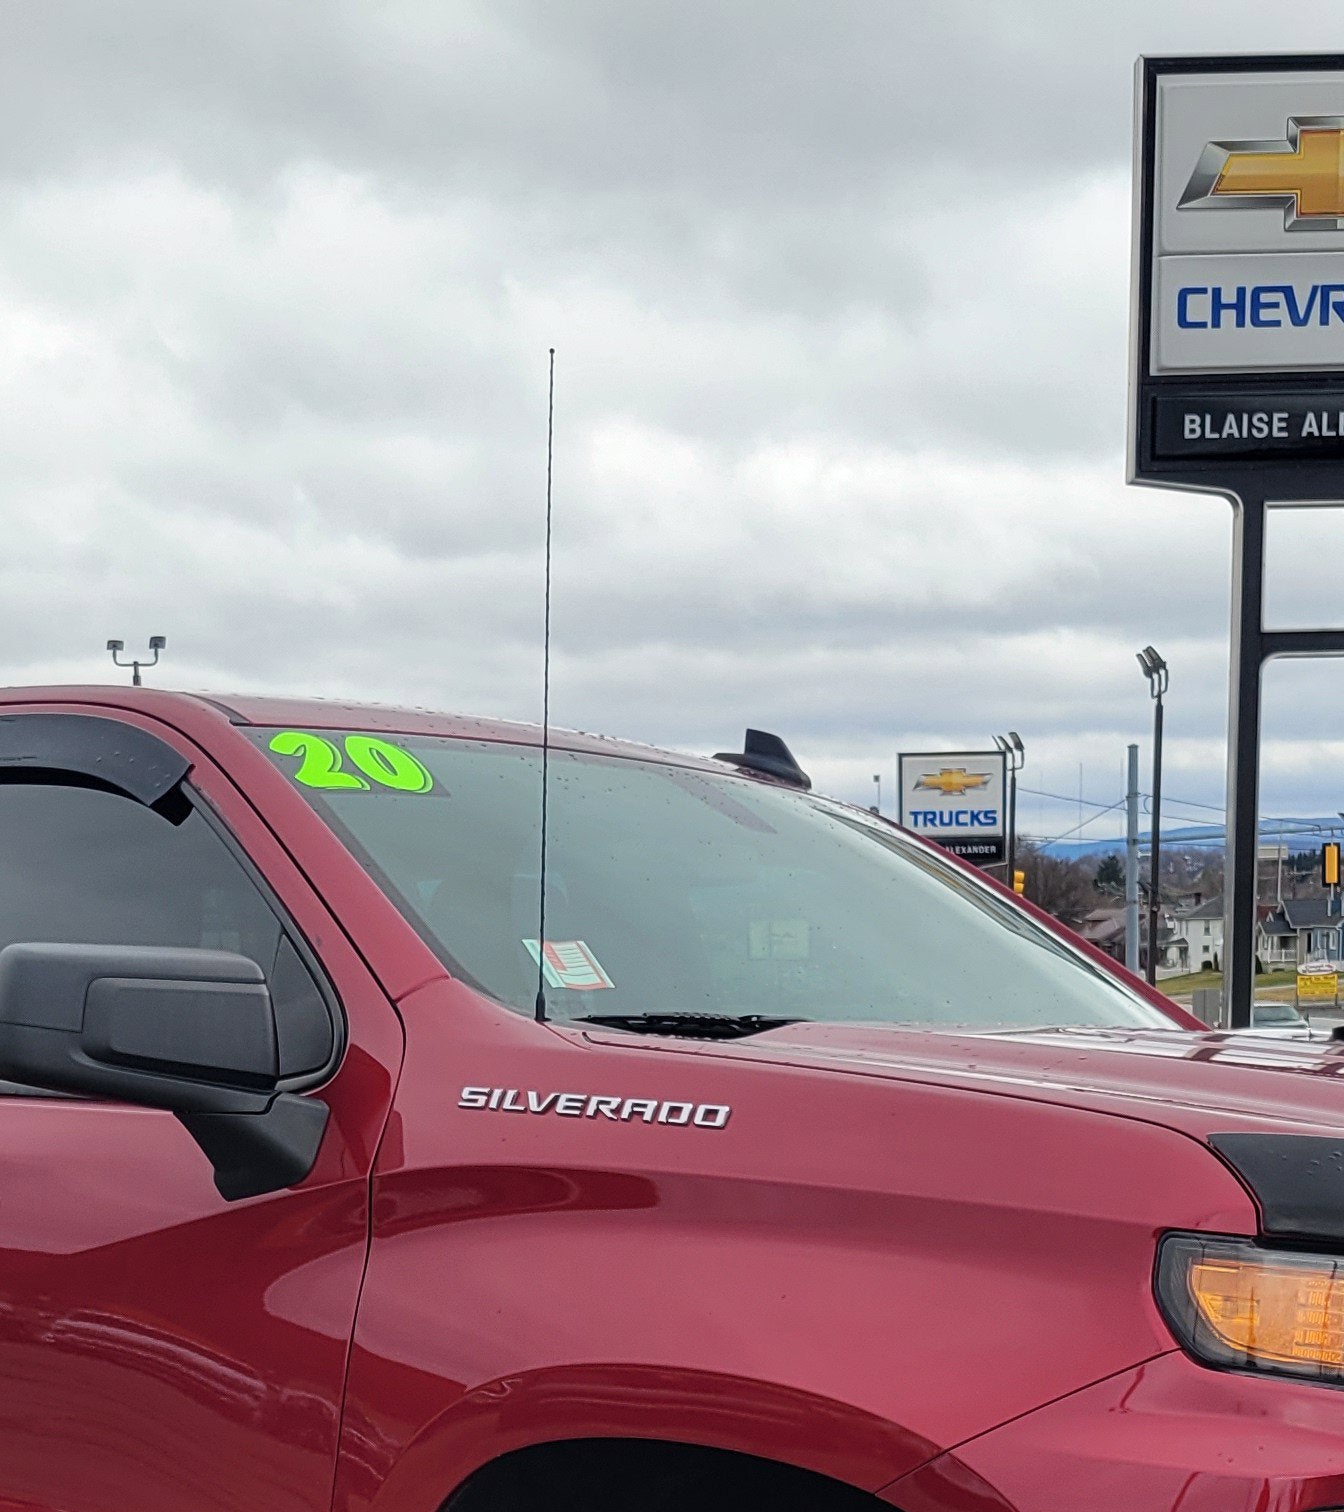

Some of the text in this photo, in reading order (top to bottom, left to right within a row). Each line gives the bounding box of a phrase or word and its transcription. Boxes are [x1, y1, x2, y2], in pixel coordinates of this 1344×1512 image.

[1183, 411, 1289, 439] BLAISE
[268, 731, 434, 794] 20
[909, 809, 997, 828] TRUCKS
[457, 1086, 732, 1128] SILVERADO
